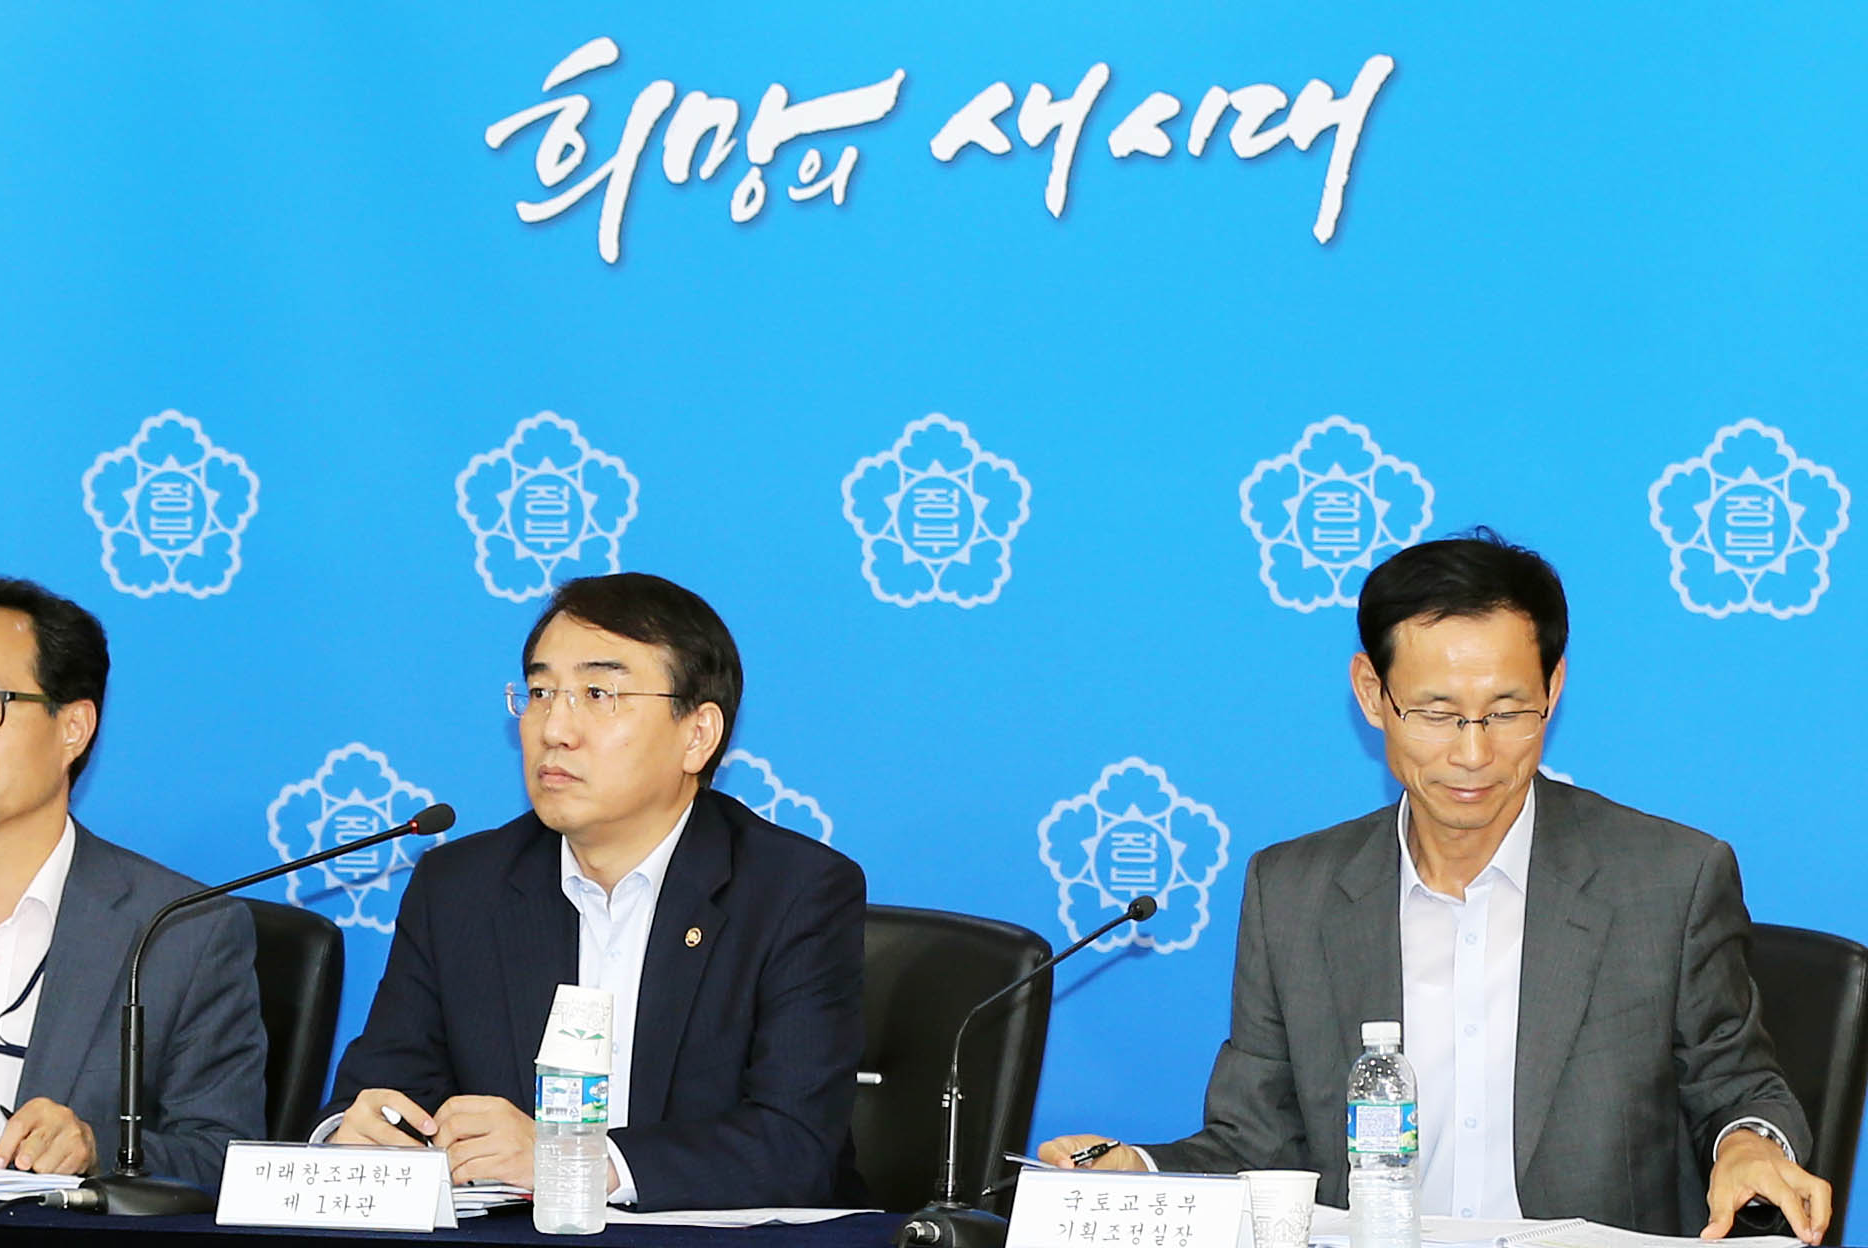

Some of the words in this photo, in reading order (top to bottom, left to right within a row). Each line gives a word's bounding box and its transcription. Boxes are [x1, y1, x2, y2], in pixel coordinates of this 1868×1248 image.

[485, 37, 907, 263] 희망의
[150, 481, 193, 547] 정부
[525, 484, 571, 551] 정부
[913, 488, 960, 553] 정부
[1313, 491, 1361, 558] 정부
[1725, 495, 1775, 563] 정부
[1110, 832, 1158, 898] 정부
[255, 1161, 414, 1186] 미래창조과학부
[1063, 1190, 1198, 1216] 국토교통부
[1057, 1221, 1193, 1247] 기획조정실장
